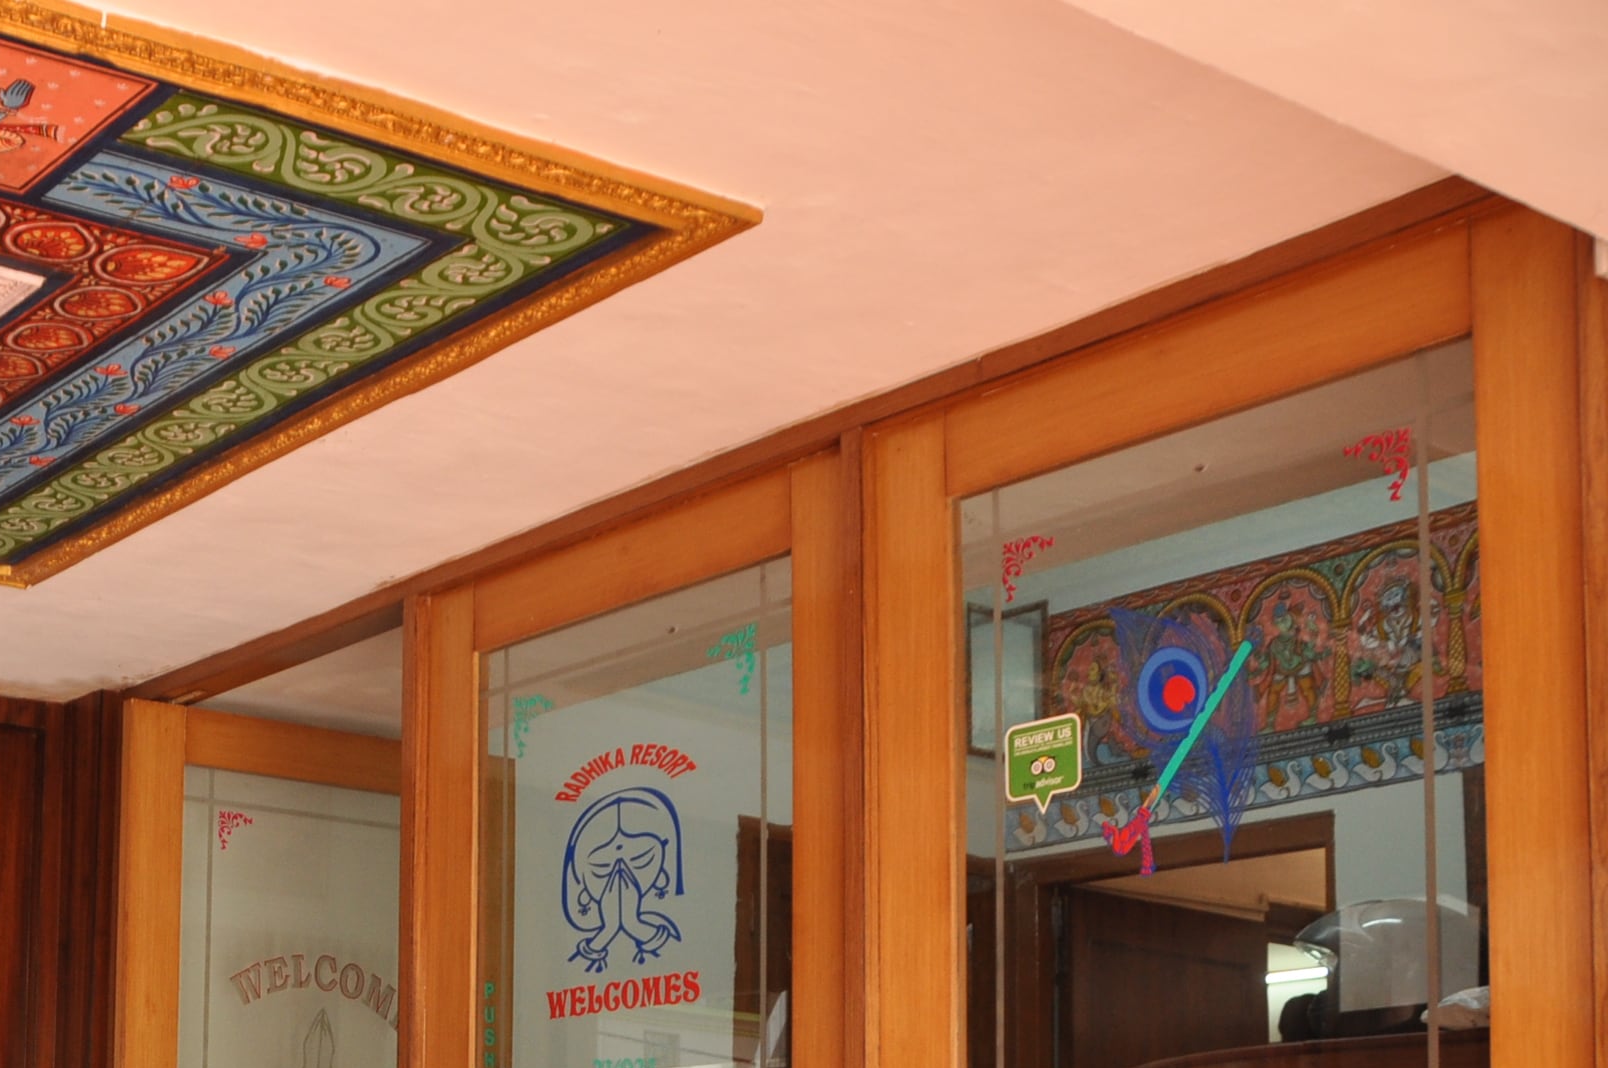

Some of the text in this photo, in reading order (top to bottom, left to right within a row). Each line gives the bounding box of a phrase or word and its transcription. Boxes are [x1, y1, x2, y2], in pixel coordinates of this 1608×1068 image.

[1014, 731, 1054, 748] REVIEW
[1057, 726, 1072, 739] US
[555, 743, 697, 803] RADHIKA RESORT
[546, 970, 701, 1020] WELCOMES
